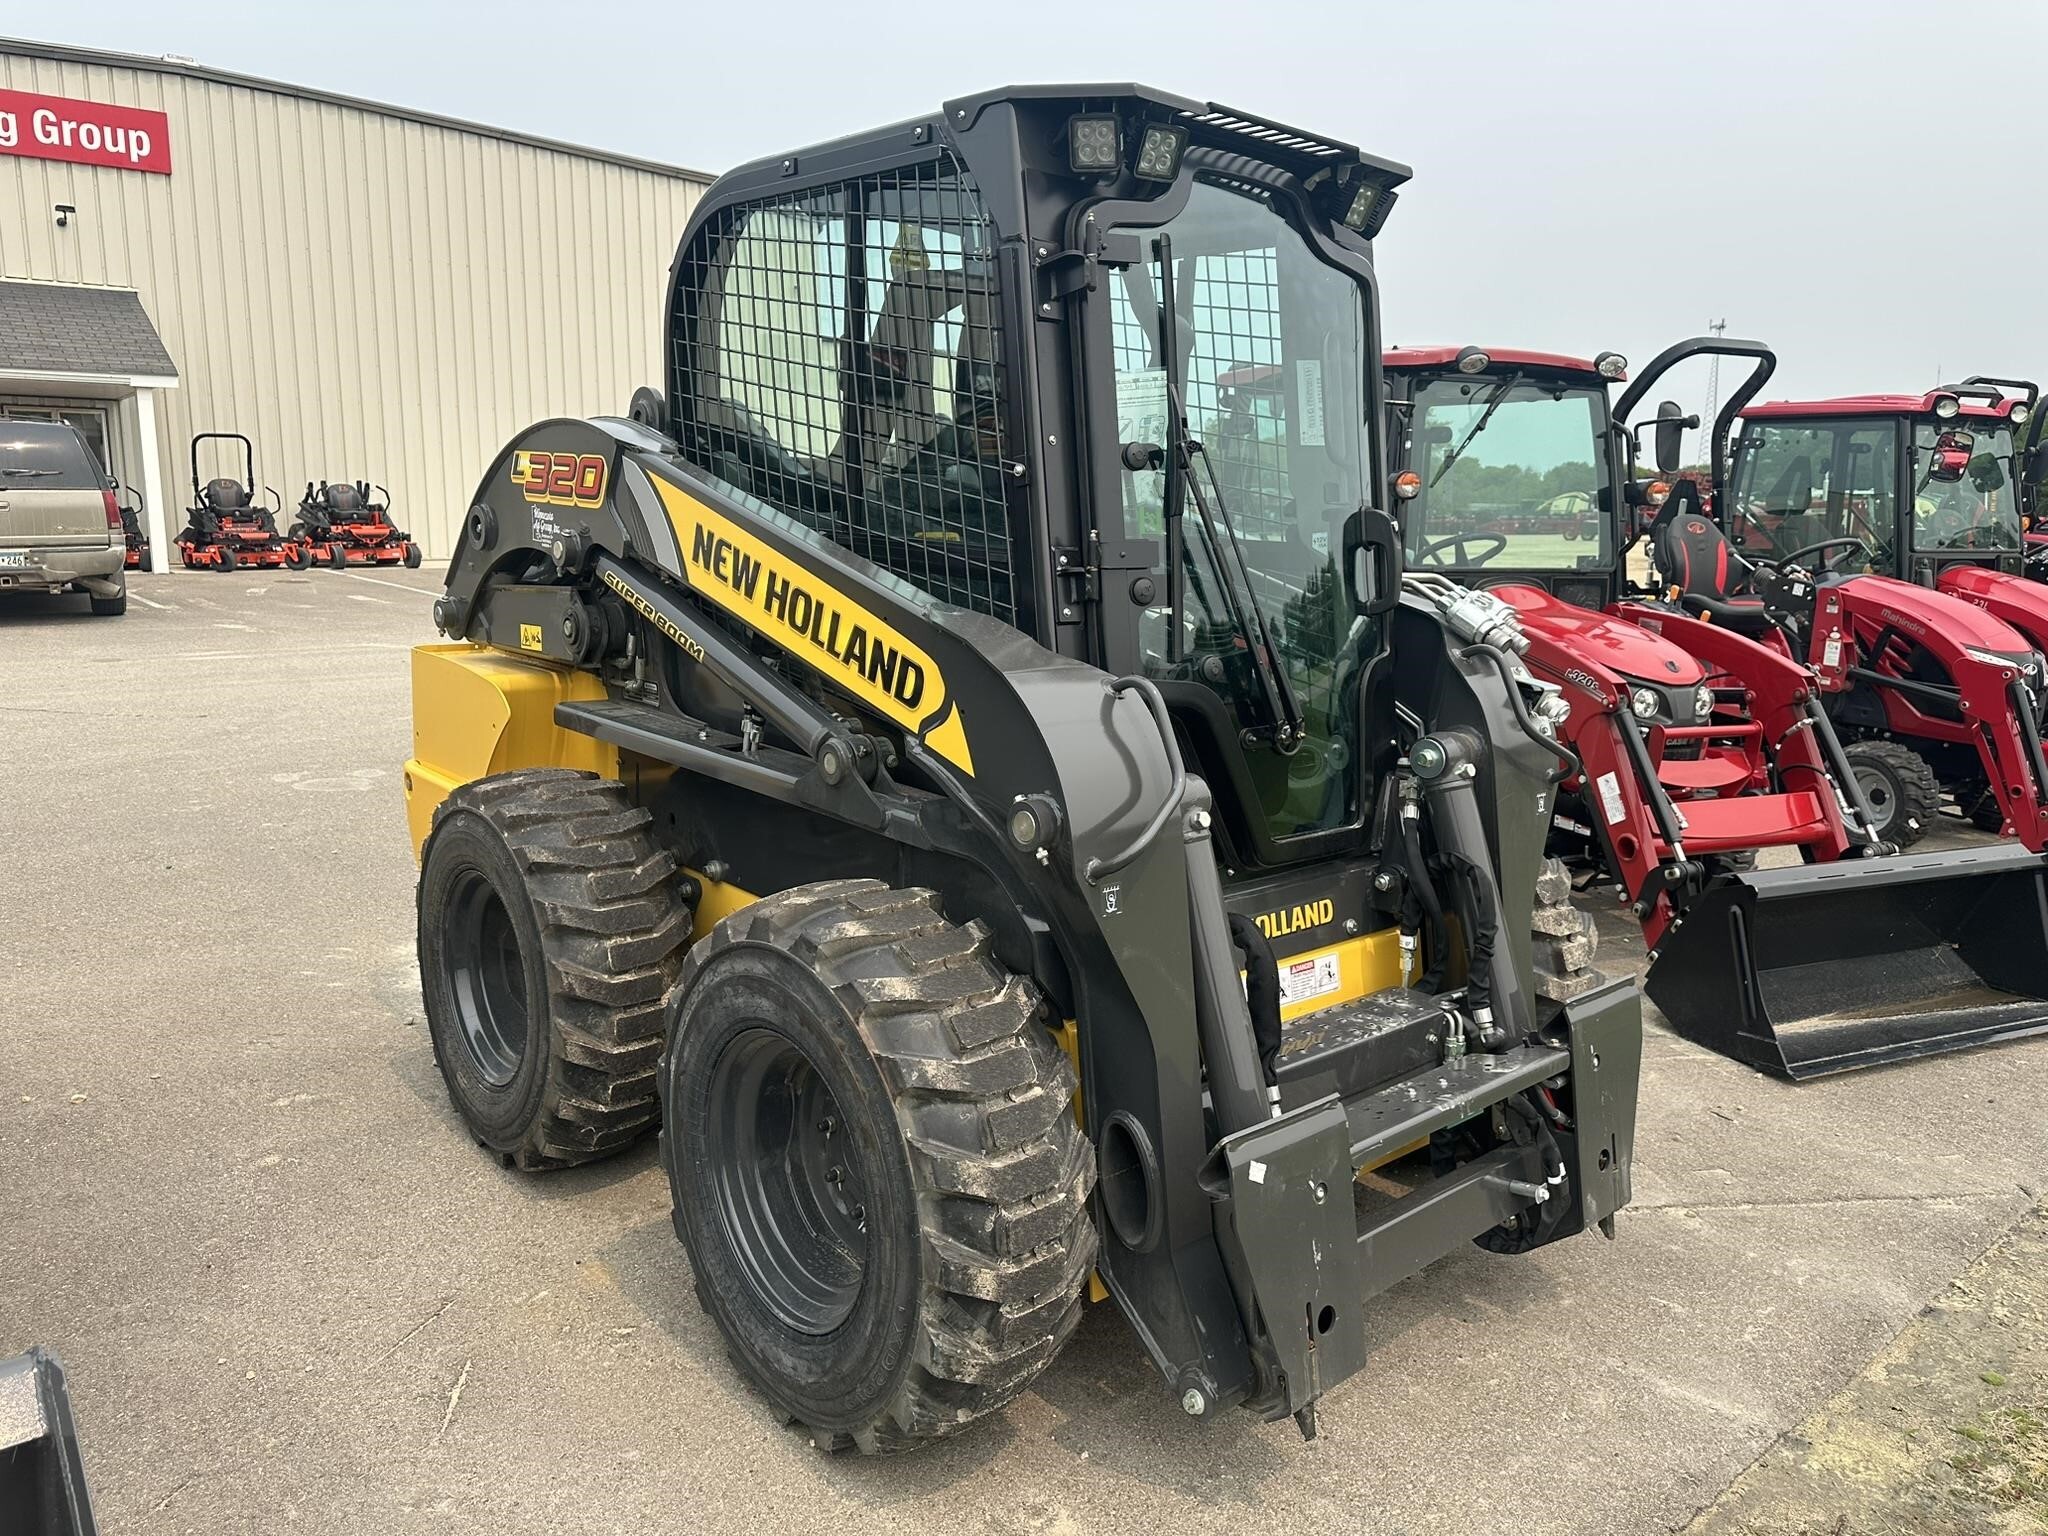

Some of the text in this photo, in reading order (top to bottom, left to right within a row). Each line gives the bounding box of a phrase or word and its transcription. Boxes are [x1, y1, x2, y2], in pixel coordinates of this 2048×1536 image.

[33, 109, 151, 163] Group
[511, 451, 607, 508] L320
[604, 570, 704, 664] SUPER BOOM
[691, 521, 926, 713] NEW HOLLAND
[1880, 608, 1926, 636] Mahindra
[1252, 898, 1335, 939] OLLAND
